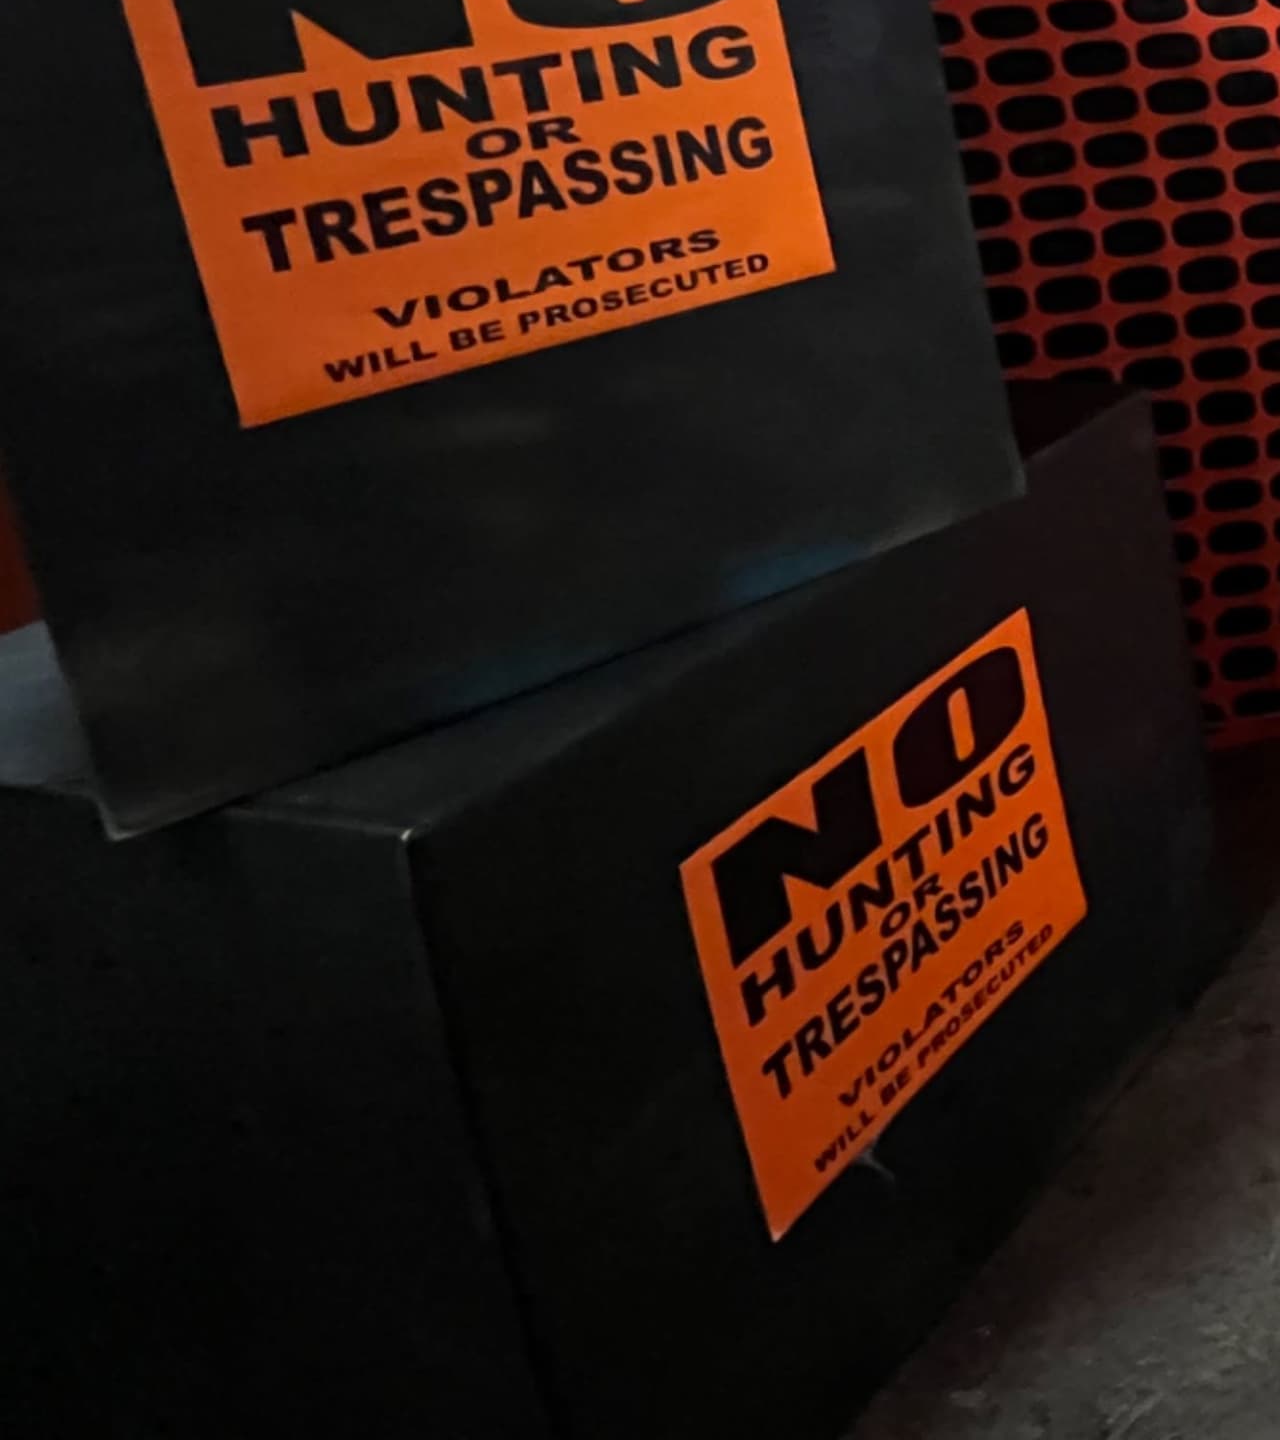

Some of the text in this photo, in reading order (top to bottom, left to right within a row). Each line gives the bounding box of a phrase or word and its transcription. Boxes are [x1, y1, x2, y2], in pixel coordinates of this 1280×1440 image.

[210, 25, 756, 167] HUNTING
[466, 116, 580, 159] OR
[242, 116, 773, 273] TRESPASSING
[324, 252, 770, 383] WILL BE PROSECUTED
[373, 229, 720, 328] VIOLATORS
[712, 645, 1026, 969] NO
[739, 743, 1037, 1028] HUNTING
[761, 812, 1048, 1099] TRESPASSING
[881, 874, 944, 939] OR
[814, 924, 1053, 1173] WILL BE PROSECUTED
[839, 920, 1024, 1107] VIOLATORS
